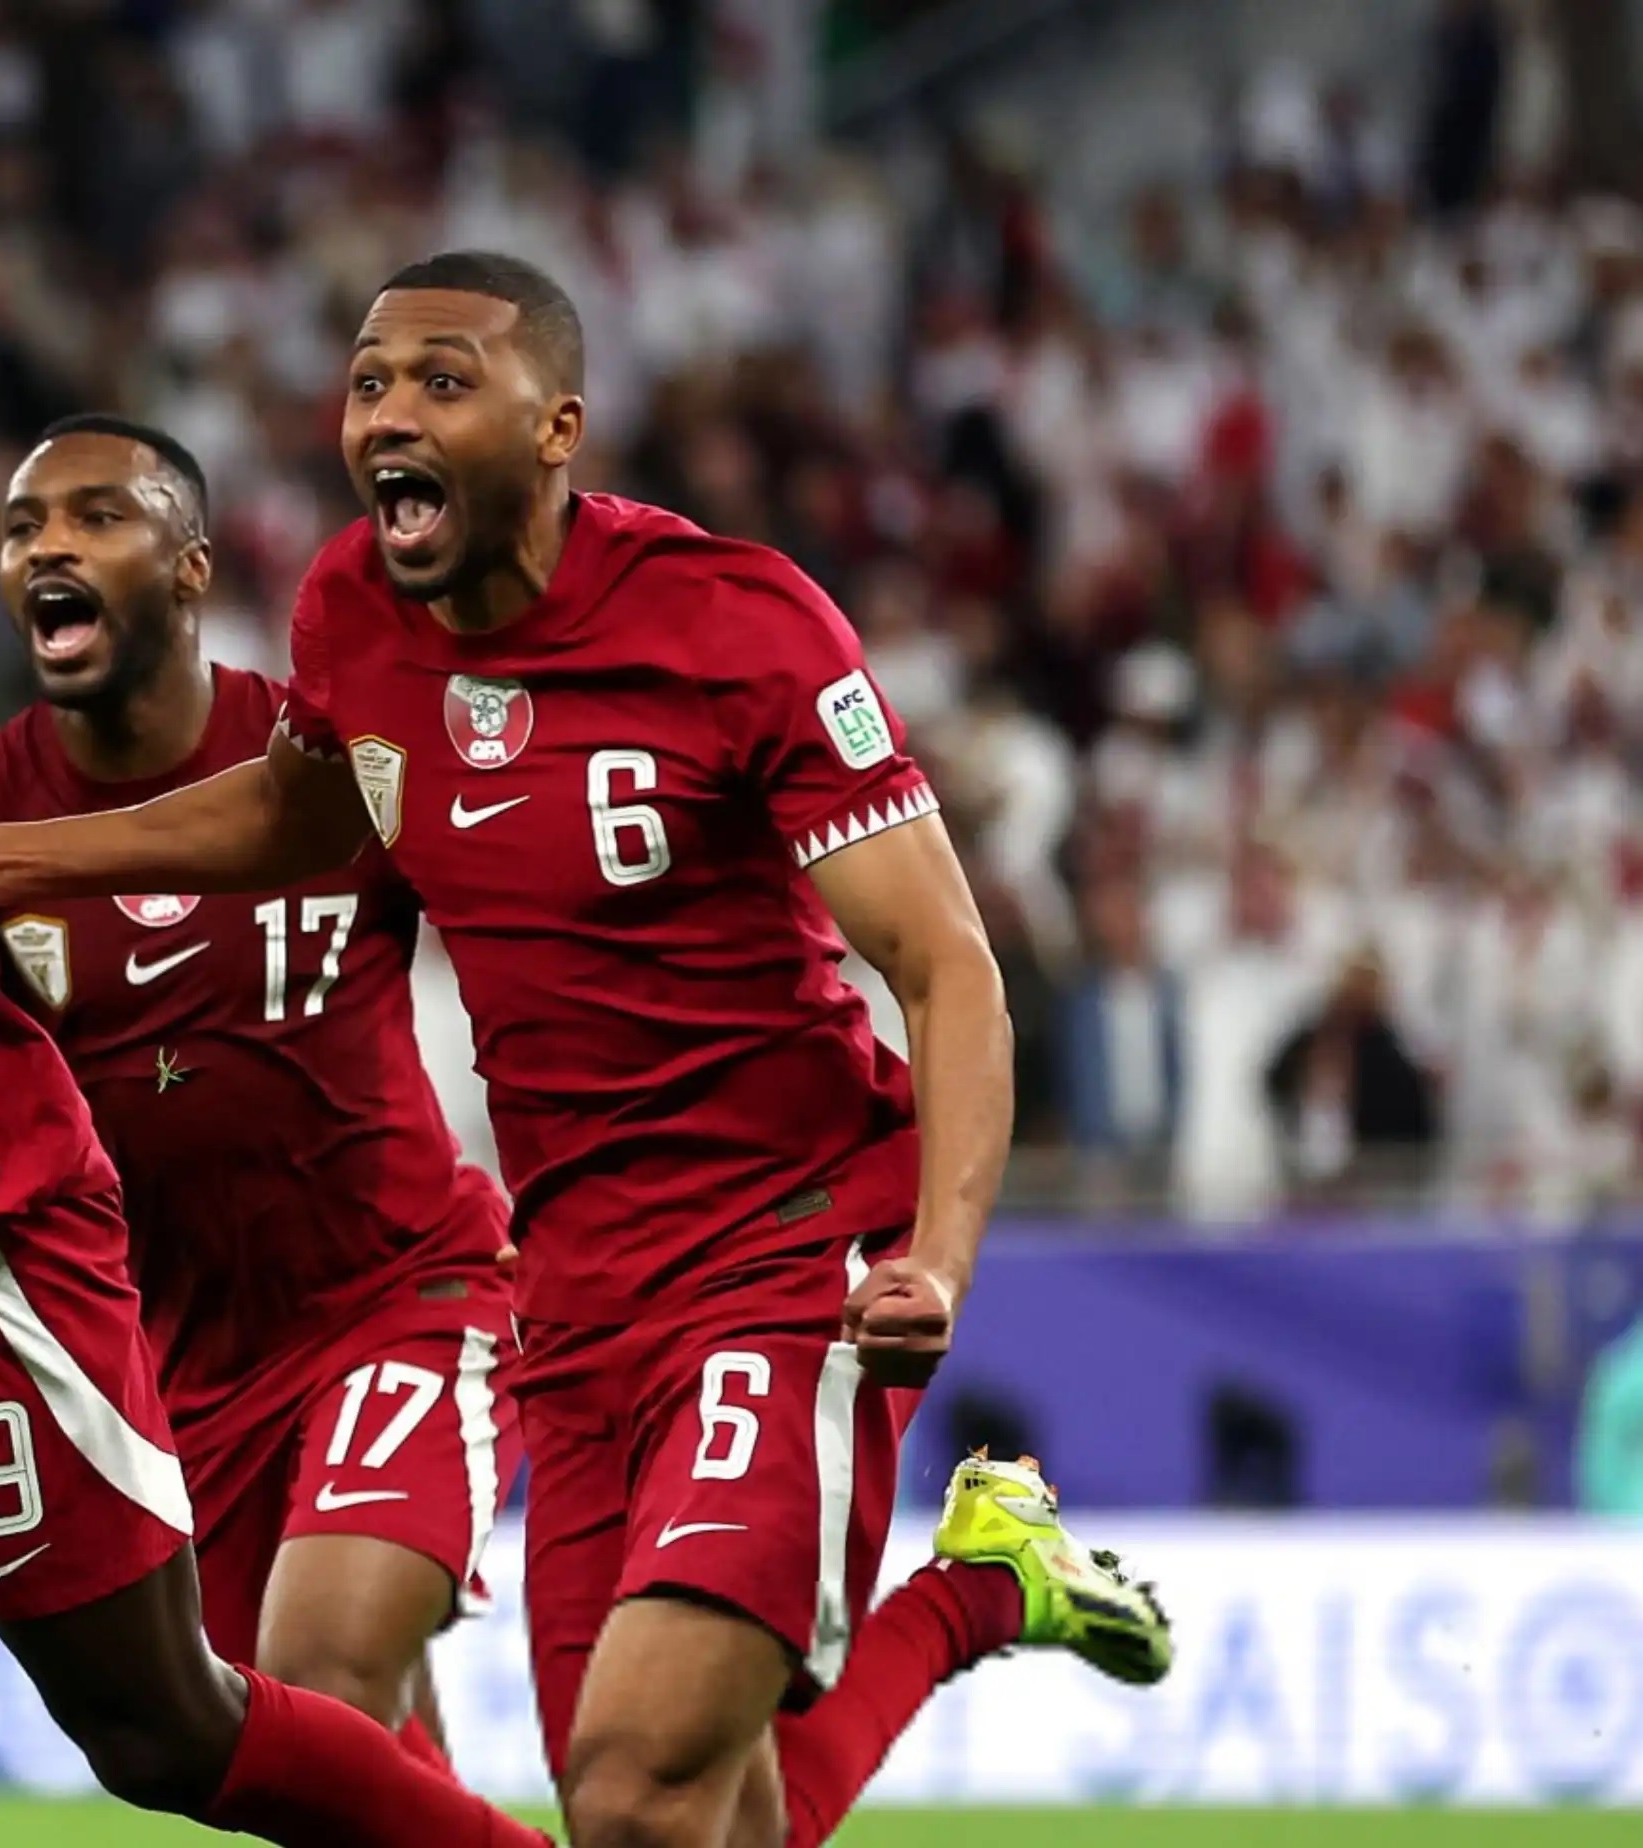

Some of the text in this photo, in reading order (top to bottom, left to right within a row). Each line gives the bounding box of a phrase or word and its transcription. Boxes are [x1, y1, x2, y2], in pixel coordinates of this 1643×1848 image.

[832, 689, 865, 715] AFC
[587, 748, 672, 887] 6
[254, 893, 359, 1022] 17
[324, 1360, 446, 1469] 17
[691, 1351, 771, 1480] 6
